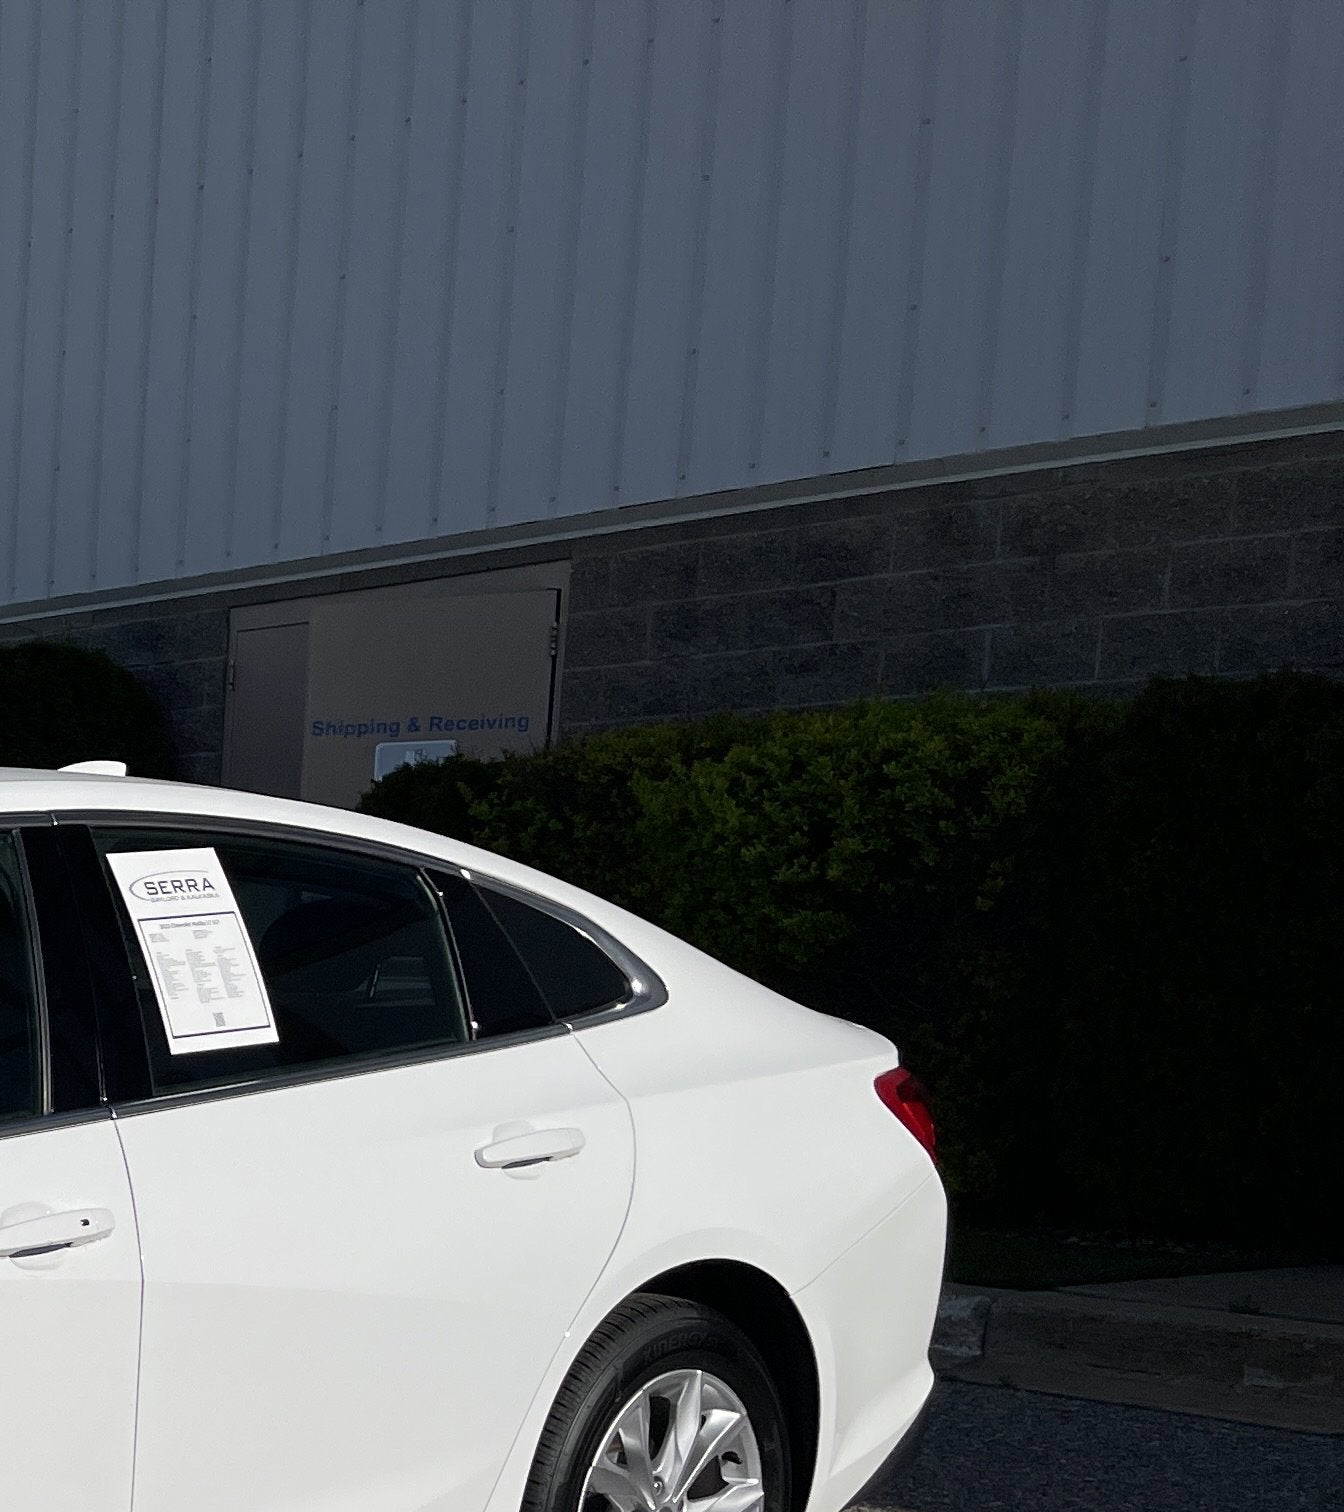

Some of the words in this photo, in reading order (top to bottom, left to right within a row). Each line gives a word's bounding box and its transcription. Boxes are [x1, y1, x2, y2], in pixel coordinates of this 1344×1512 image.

[311, 719, 401, 739] Shipping
[407, 717, 421, 733] &
[429, 713, 530, 734] Receiving
[143, 877, 216, 896] SERRA
